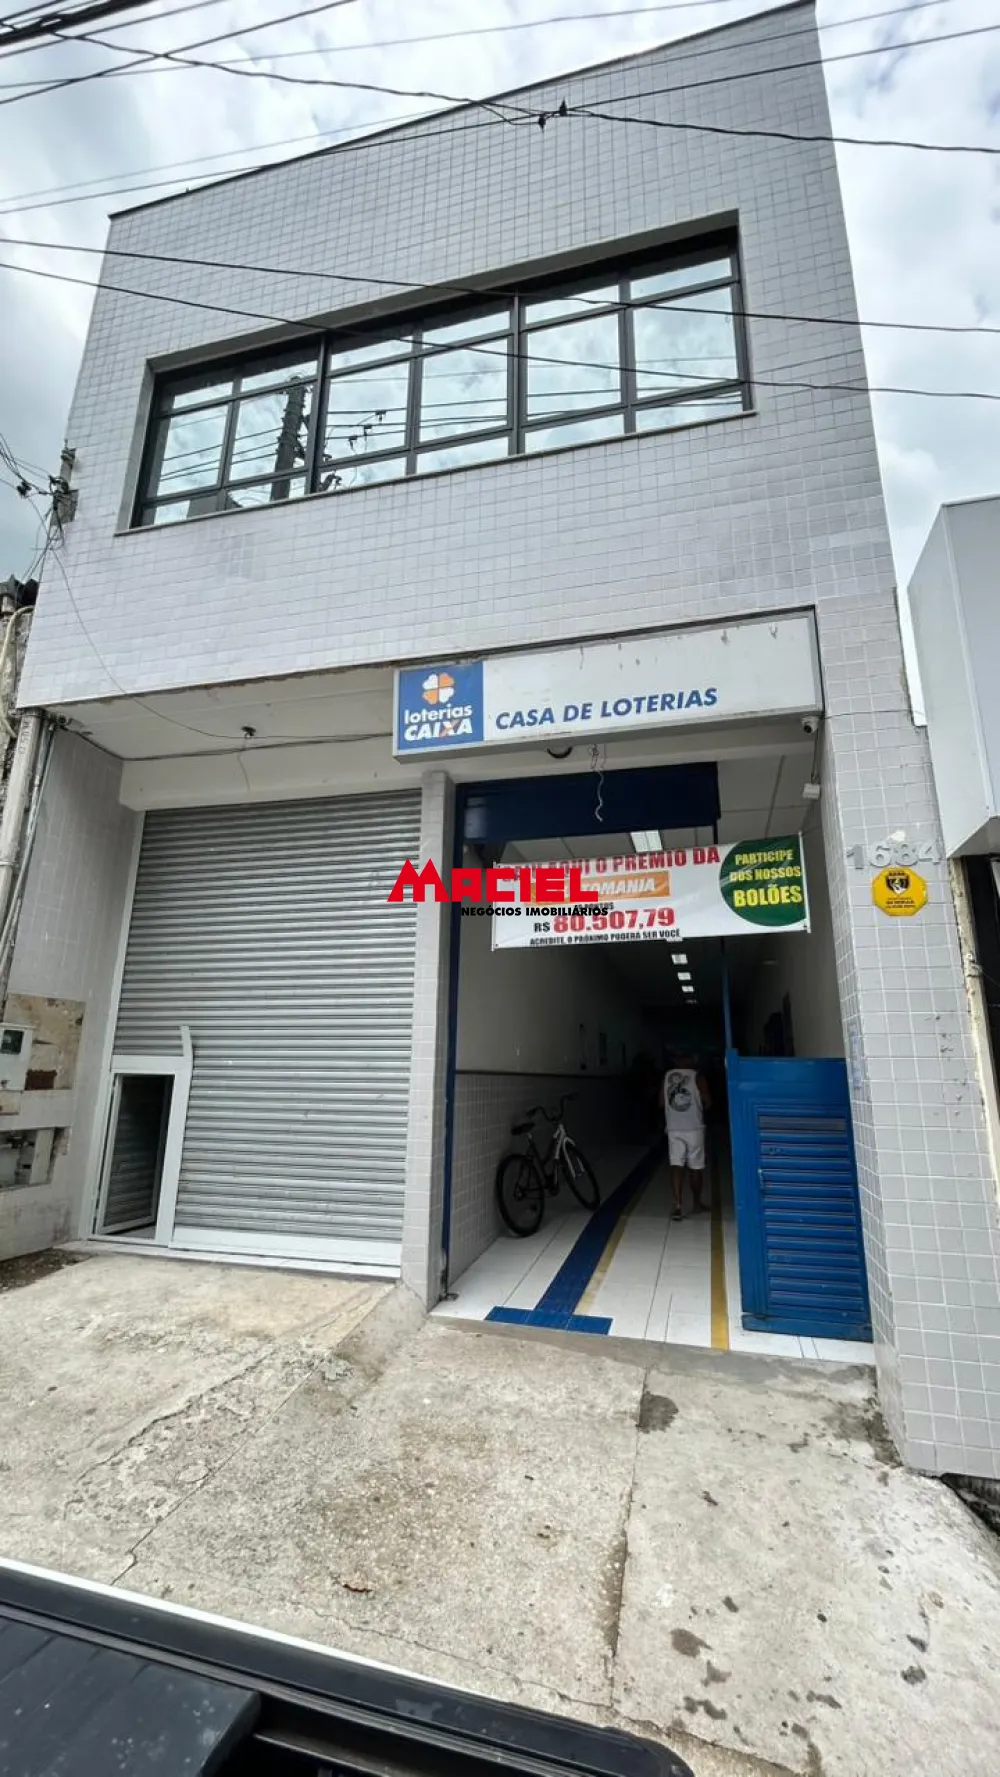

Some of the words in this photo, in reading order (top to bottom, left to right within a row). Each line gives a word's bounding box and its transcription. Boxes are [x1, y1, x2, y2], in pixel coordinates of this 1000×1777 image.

[404, 704, 473, 724] loterias
[495, 707, 555, 730] CASA
[563, 703, 593, 722] DE
[600, 687, 718, 718] LOTERIAS
[404, 719, 473, 741] CAIXA
[596, 857, 607, 873] O
[692, 846, 721, 865] DA
[735, 849, 793, 865] PARTICIPE
[846, 843, 942, 870] 1684
[728, 870, 752, 883] DOS
[754, 865, 801, 880] NOSSOS
[733, 884, 802, 907] BOLÕES
